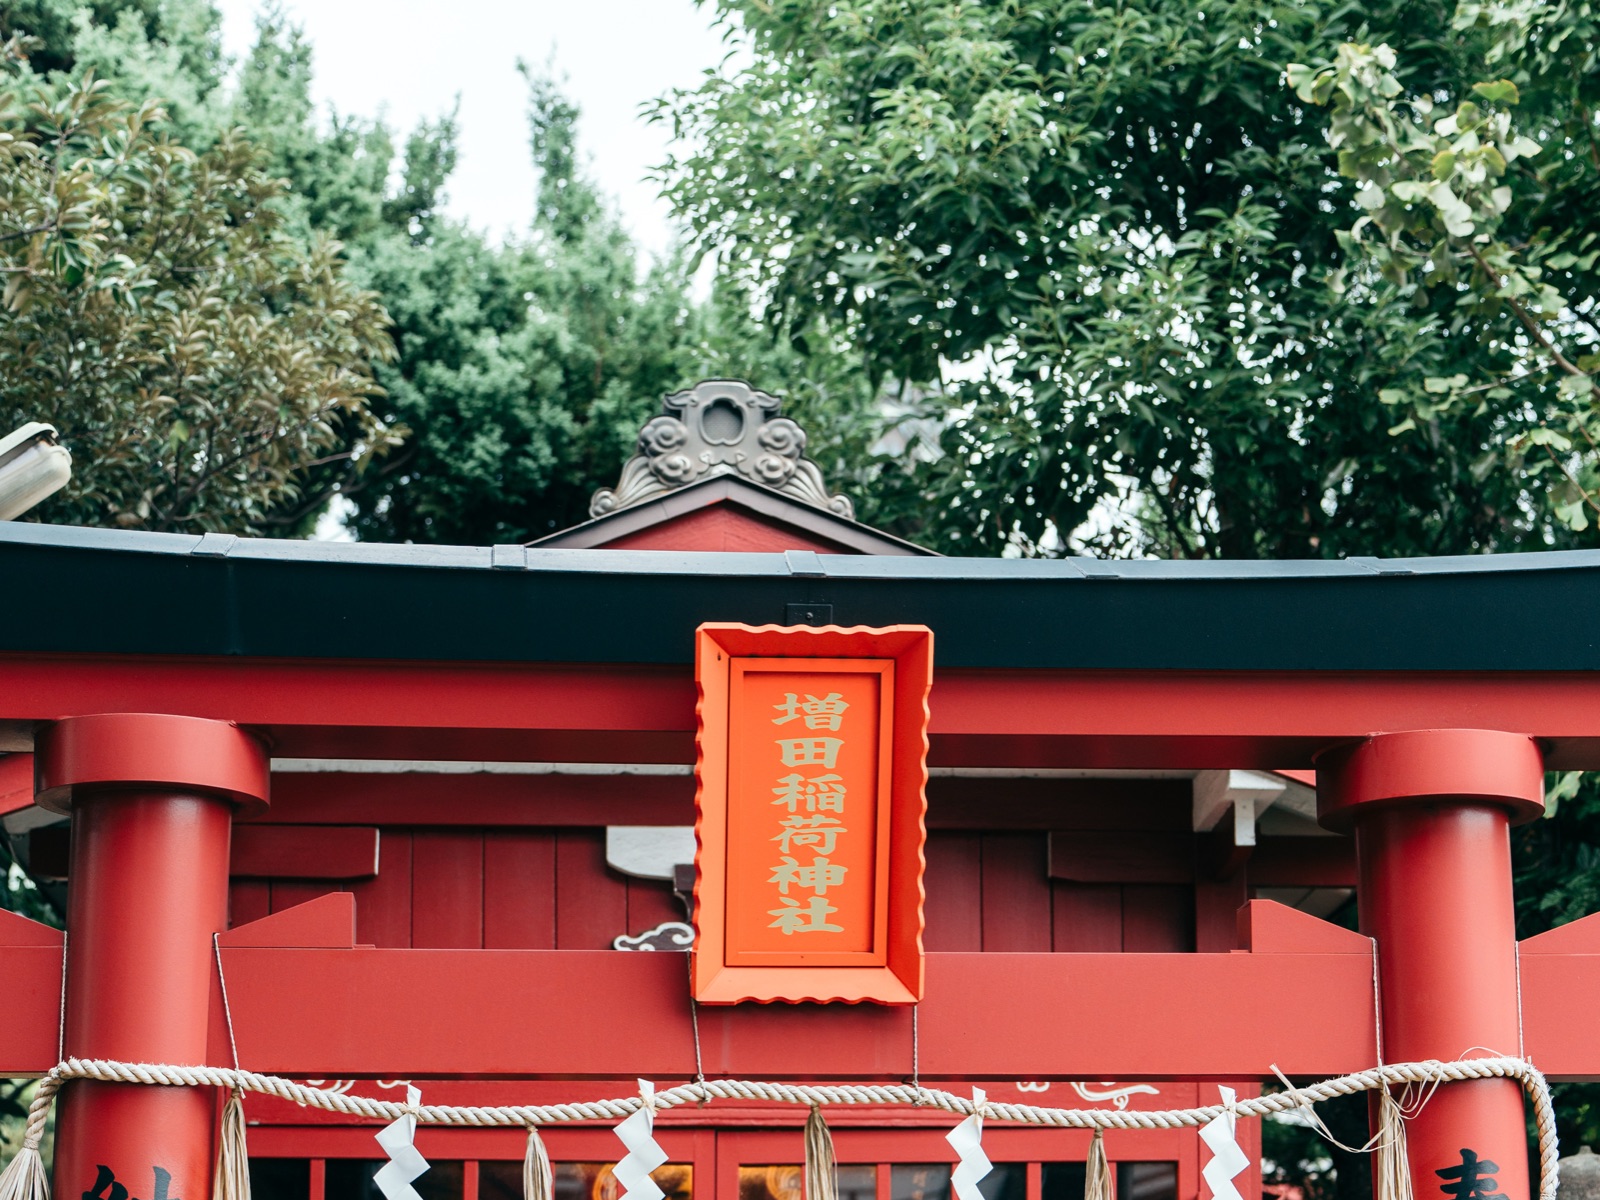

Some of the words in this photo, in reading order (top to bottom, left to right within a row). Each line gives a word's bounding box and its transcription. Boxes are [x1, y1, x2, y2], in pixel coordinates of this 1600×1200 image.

[766, 692, 851, 936] 増田稲荷神社
